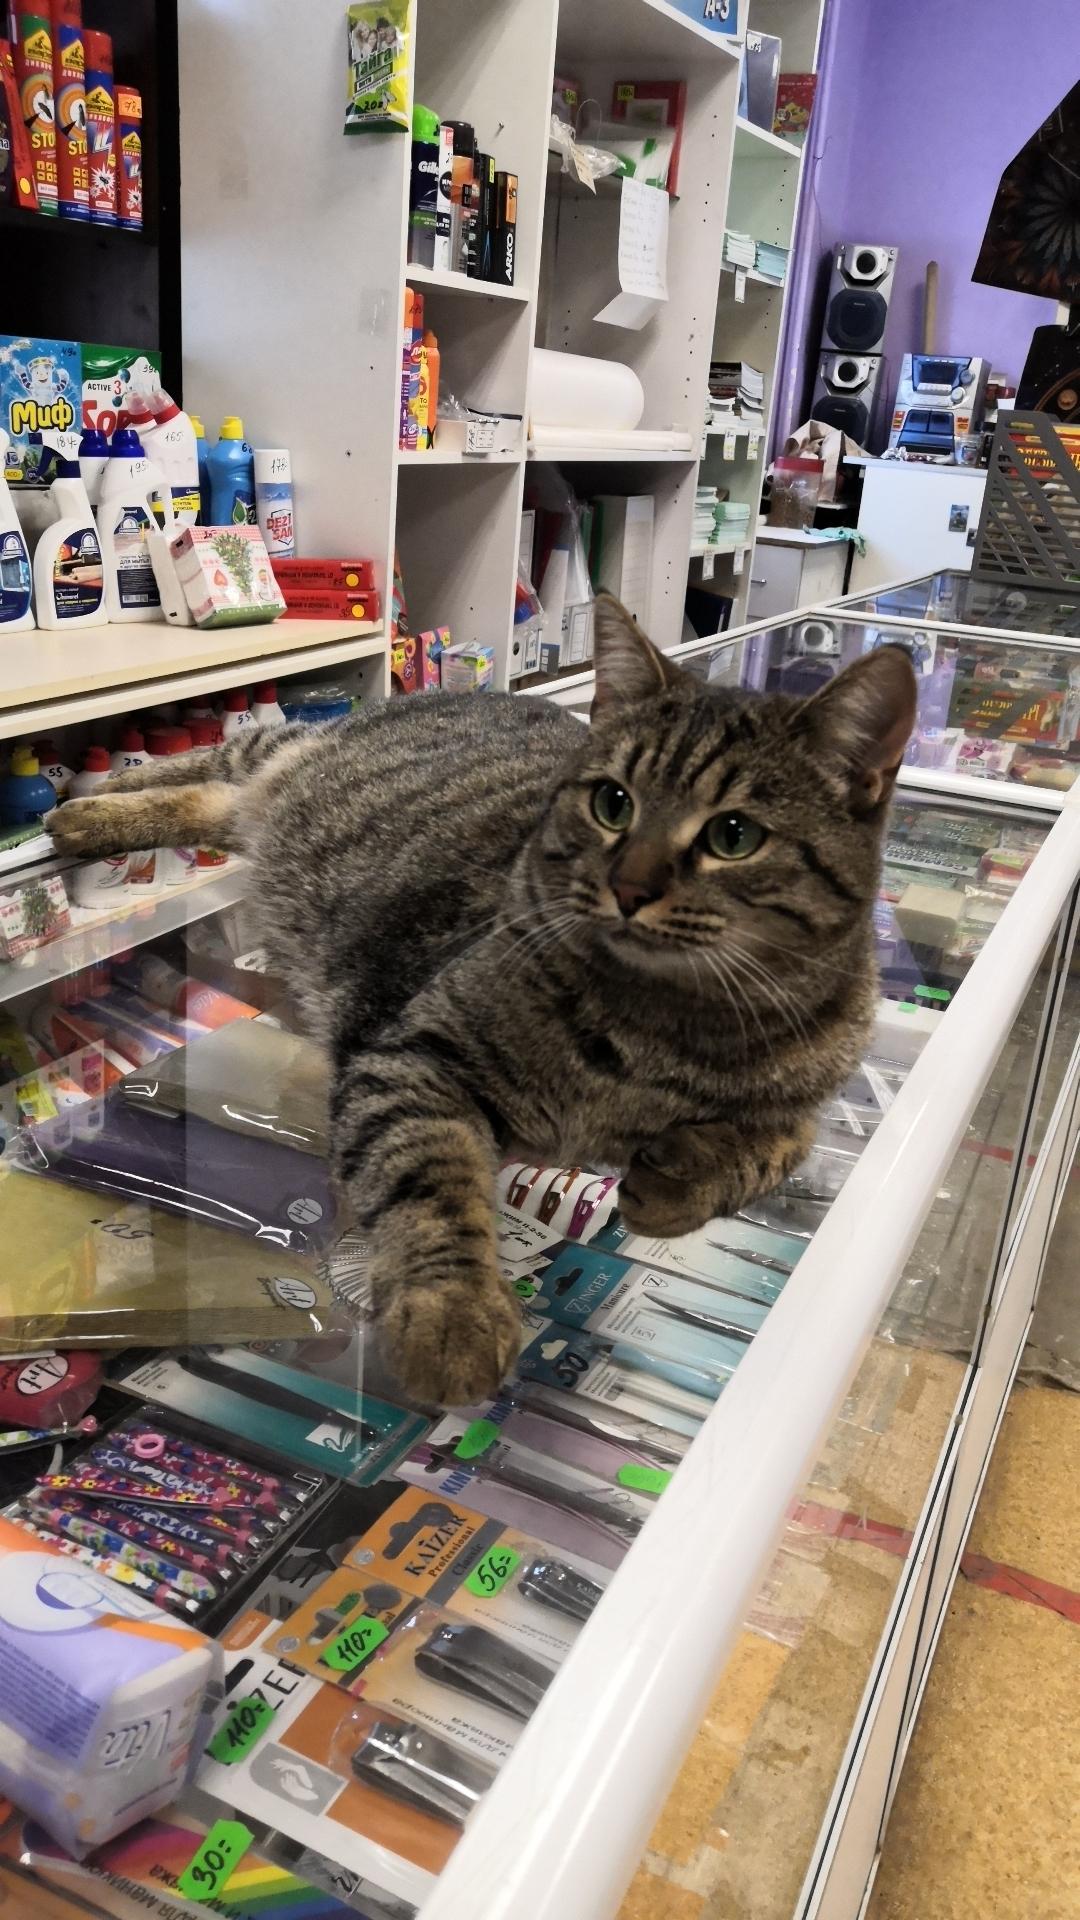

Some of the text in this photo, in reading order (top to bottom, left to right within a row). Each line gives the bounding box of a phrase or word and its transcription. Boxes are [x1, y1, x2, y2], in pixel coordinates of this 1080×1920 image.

[505, 232, 515, 283] ARKO
[87, 379, 122, 395] ACTIVE 3
[10, 395, 74, 435] Миф
[404, 1515, 468, 1578] KAIZER
[427, 1526, 475, 1578] Professional
